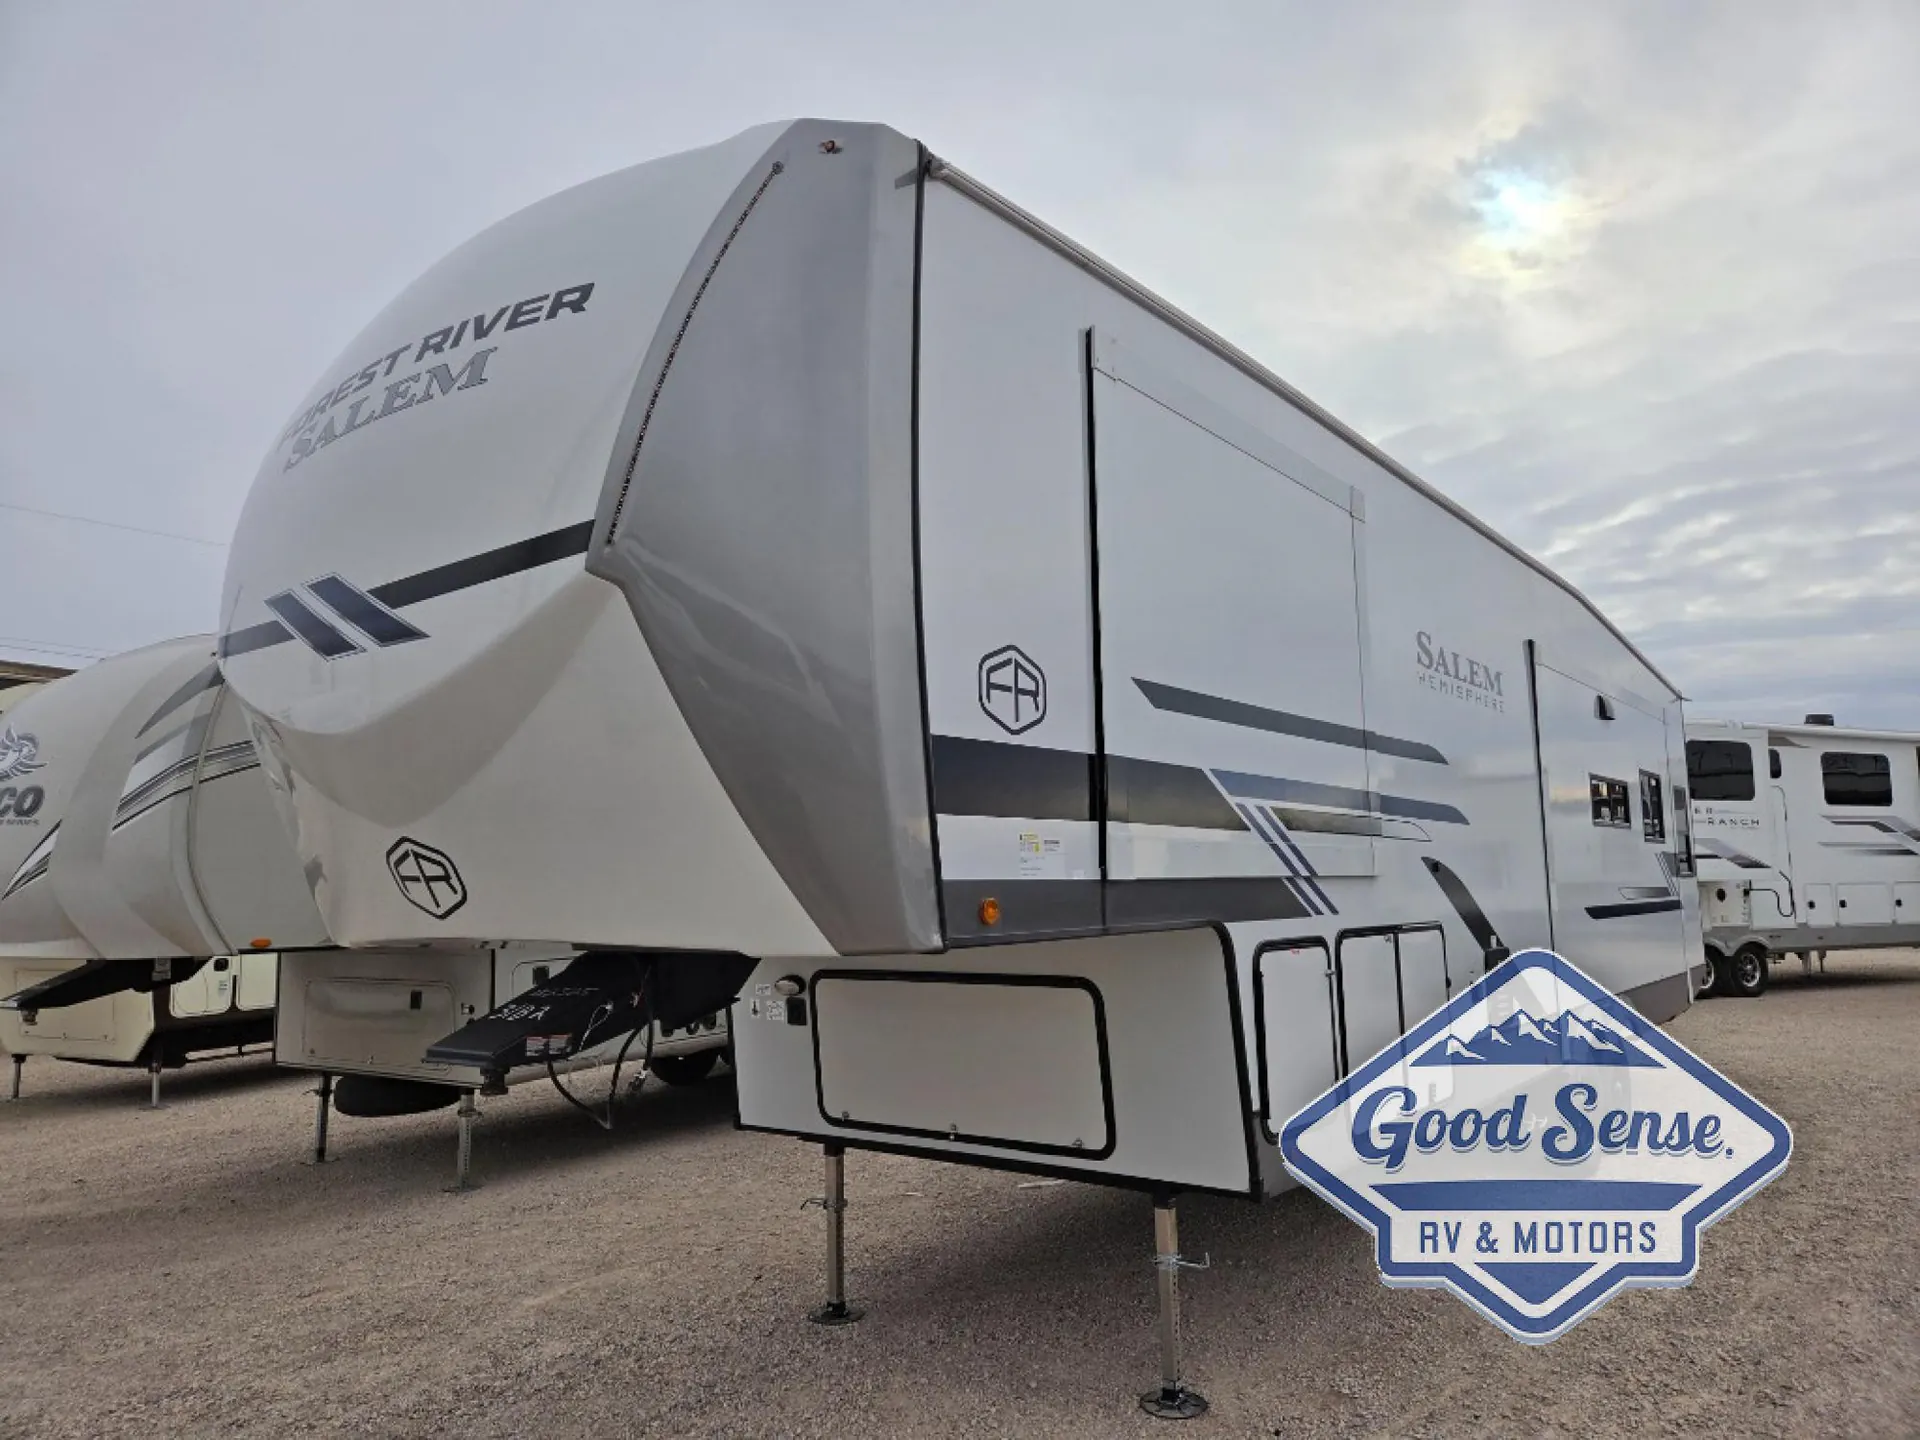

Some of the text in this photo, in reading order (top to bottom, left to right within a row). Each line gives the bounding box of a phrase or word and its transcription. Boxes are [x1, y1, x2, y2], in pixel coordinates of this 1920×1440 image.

[414, 282, 595, 363] RIVER
[283, 347, 499, 473] SALEM
[1415, 630, 1504, 697] SALEM
